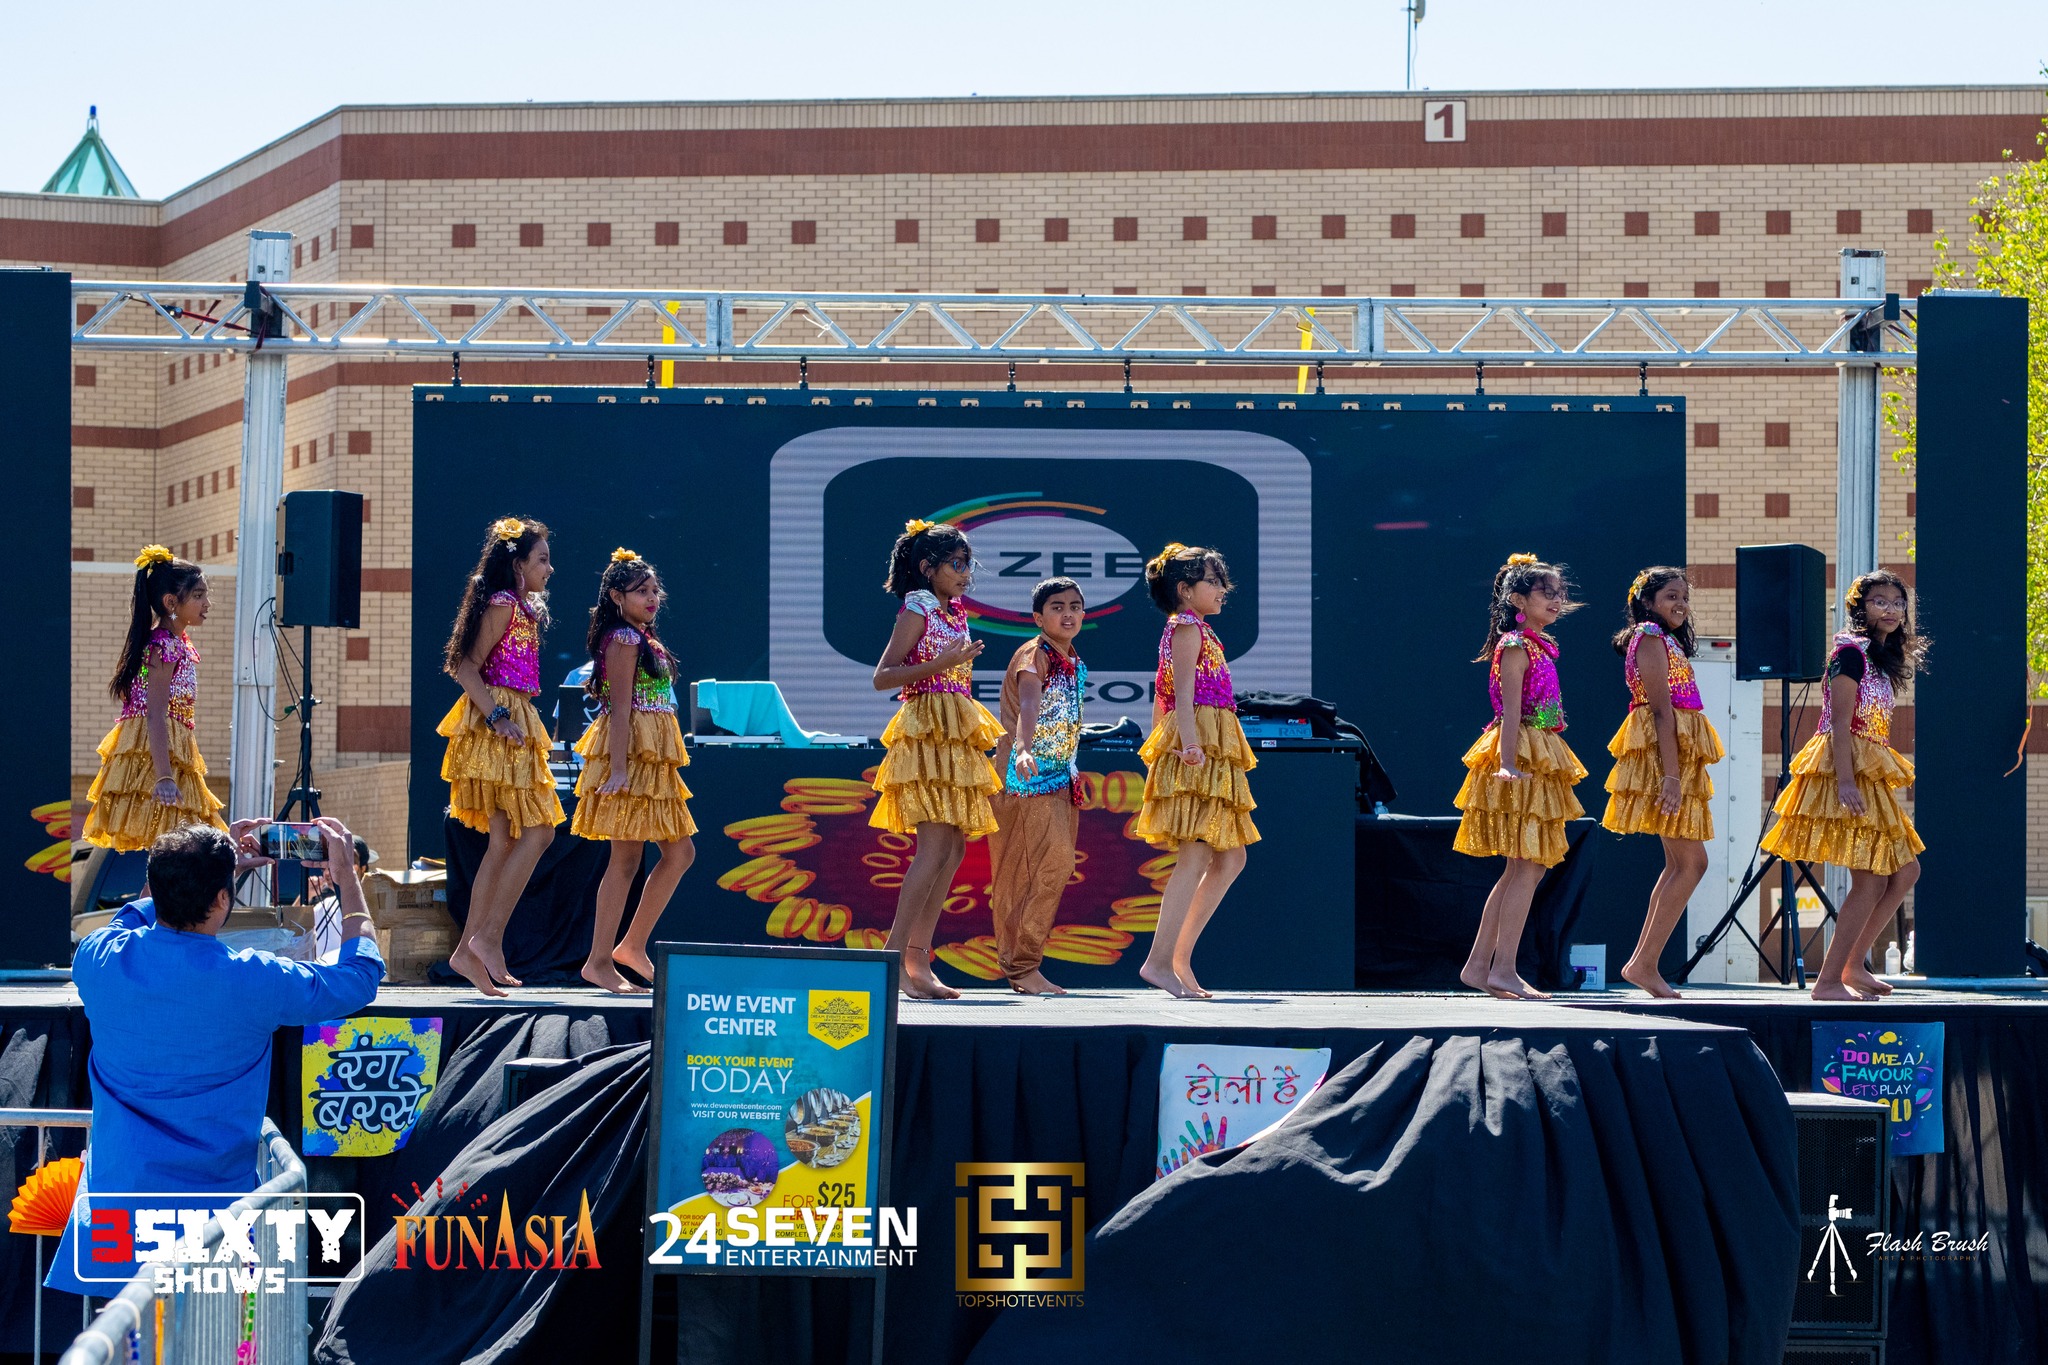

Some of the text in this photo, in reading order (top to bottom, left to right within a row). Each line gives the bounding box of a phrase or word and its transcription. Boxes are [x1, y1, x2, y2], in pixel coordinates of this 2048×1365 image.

[1433, 104, 1453, 138] 1
[999, 552, 1143, 578] ZEE
[687, 993, 796, 1014] DEW EVENT
[704, 1017, 777, 1036] CENTER
[337, 1035, 410, 1091] रंग
[687, 1054, 794, 1068] BOOK YOUR EVENT
[1841, 1049, 1915, 1066] DO ME A
[687, 1066, 793, 1095] TODAY
[1842, 1064, 1914, 1083] FAVOUR
[1184, 1063, 1301, 1106] होली है
[1843, 1083, 1912, 1097] LETS PLAY
[318, 1075, 427, 1133] बरसे
[691, 1102, 782, 1111] www.deweventcenter.com
[692, 1110, 781, 1120] VISIT OUR WEBSITE
[783, 1181, 856, 1208] FOR $25
